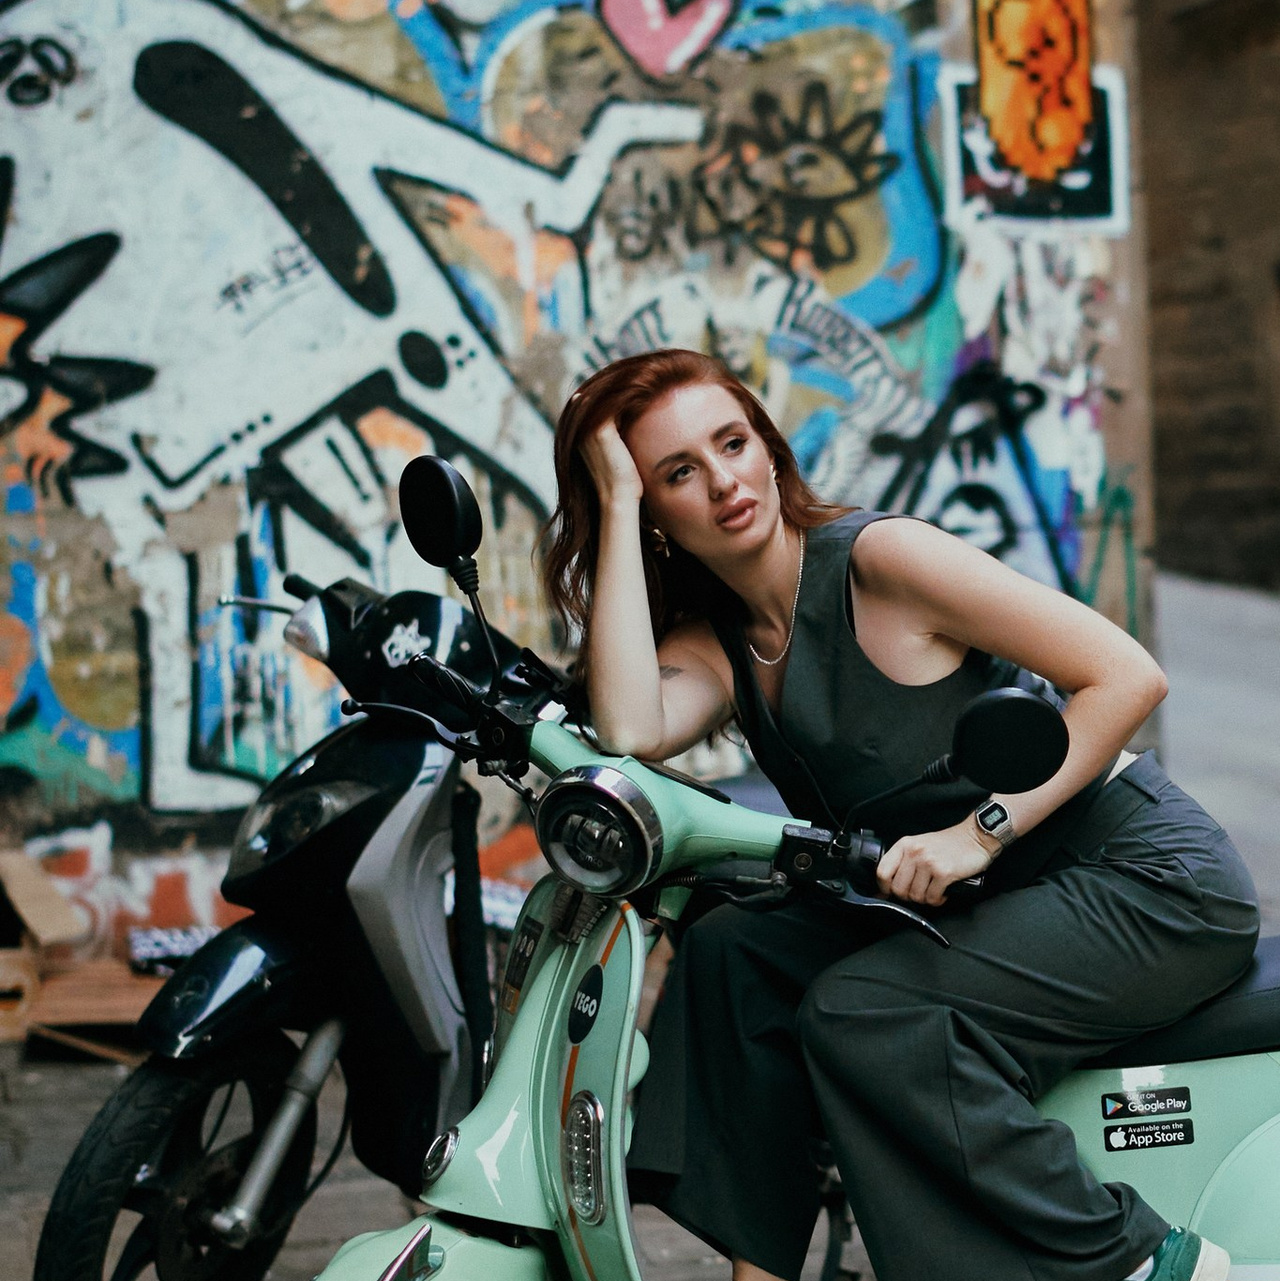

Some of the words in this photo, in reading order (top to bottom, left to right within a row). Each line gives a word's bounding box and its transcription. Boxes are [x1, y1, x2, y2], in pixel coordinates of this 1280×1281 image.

[573, 990, 598, 1018] YEGO
[1128, 1100, 1165, 1113] Google
[1166, 1098, 1187, 1109] Play
[1128, 1124, 1160, 1133] Available
[1129, 1133, 1153, 1147] App
[1154, 1131, 1185, 1143] Store
